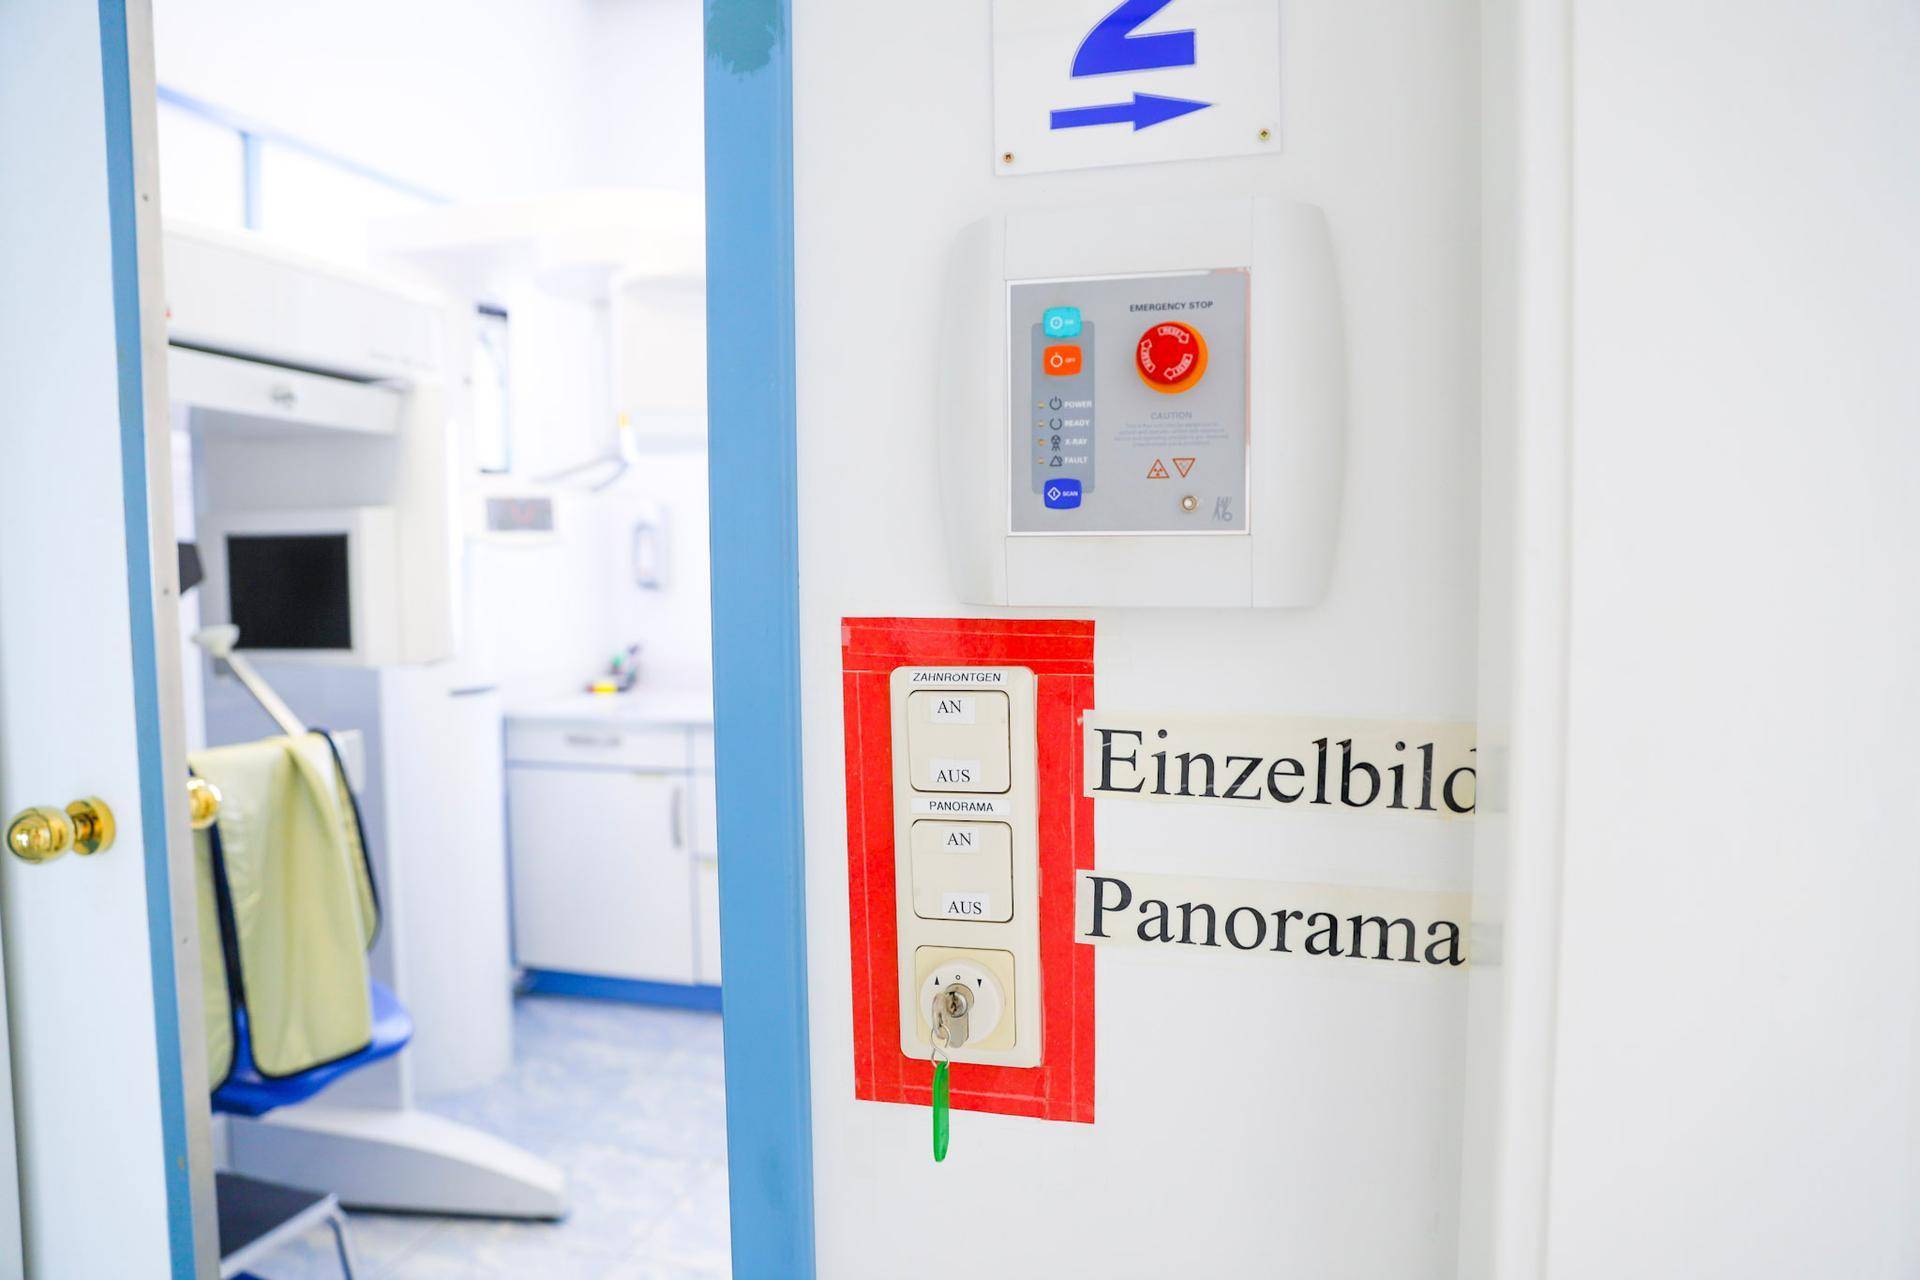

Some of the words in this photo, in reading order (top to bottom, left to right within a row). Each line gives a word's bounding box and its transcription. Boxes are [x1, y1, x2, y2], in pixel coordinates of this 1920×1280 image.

[1129, 301, 1187, 312] EMERGENCY
[1189, 300, 1214, 309] STOP
[1064, 400, 1092, 409] POWER
[1150, 411, 1193, 420] CAUTION
[1064, 419, 1090, 427] READY
[1064, 438, 1088, 446] X-RAY
[1064, 456, 1089, 465] FAULT
[913, 672, 1001, 682] ZAHNRÖNTGEN
[937, 700, 962, 714] AN
[936, 769, 971, 783] AUS
[929, 801, 994, 812] PANORAMA
[947, 833, 972, 846] AN
[948, 901, 982, 915] AUS
[1085, 876, 1466, 967] Panorama
